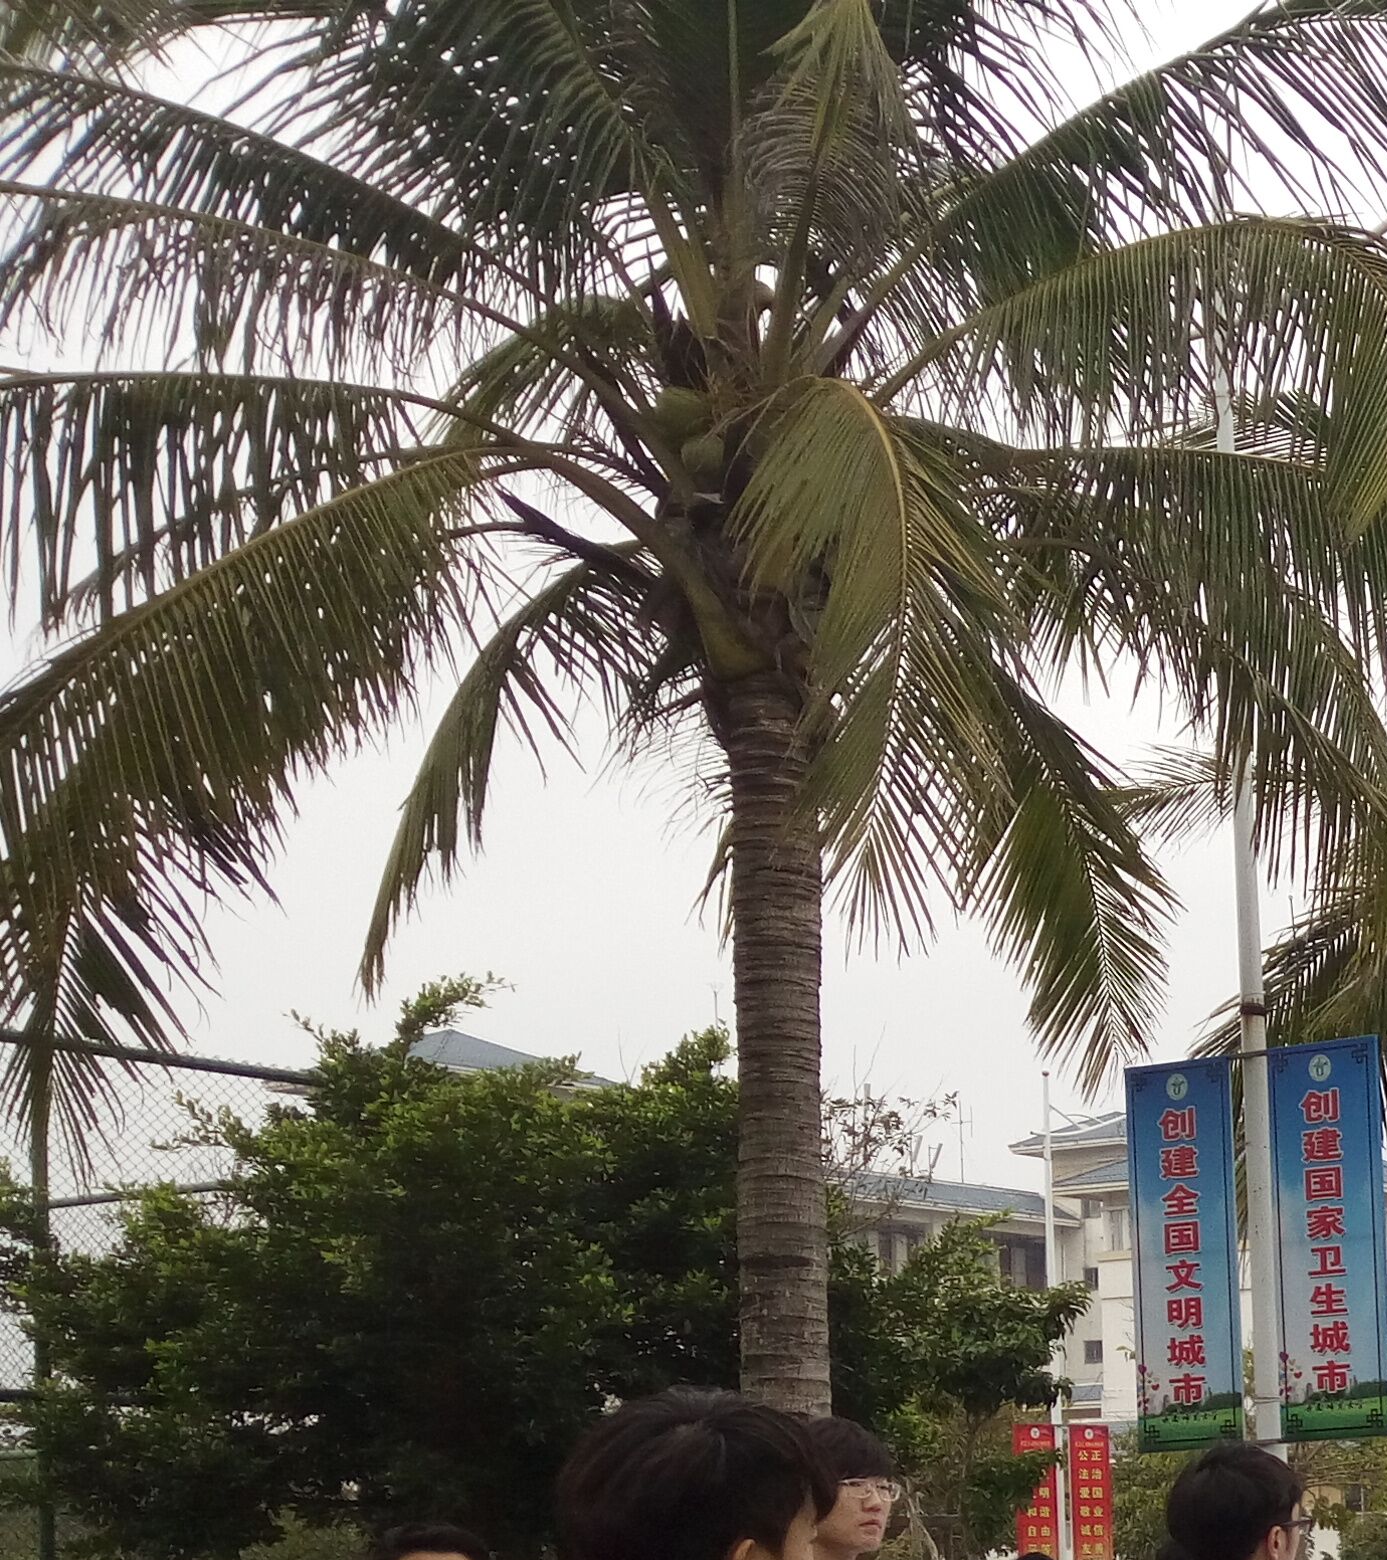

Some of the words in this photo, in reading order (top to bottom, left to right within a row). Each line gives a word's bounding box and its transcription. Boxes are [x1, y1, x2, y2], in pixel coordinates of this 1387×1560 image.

[1300, 1087, 1351, 1394] 创建国家卫生城市
[1157, 1105, 1206, 1406] 创建全国文明城市
[1078, 1449, 1102, 1461] 公正
[1079, 1468, 1102, 1480] 法治
[1079, 1487, 1104, 1499] 爱国
[1080, 1506, 1104, 1518] 敬业
[1028, 1525, 1051, 1537] 自由
[1080, 1524, 1104, 1536] 诚信
